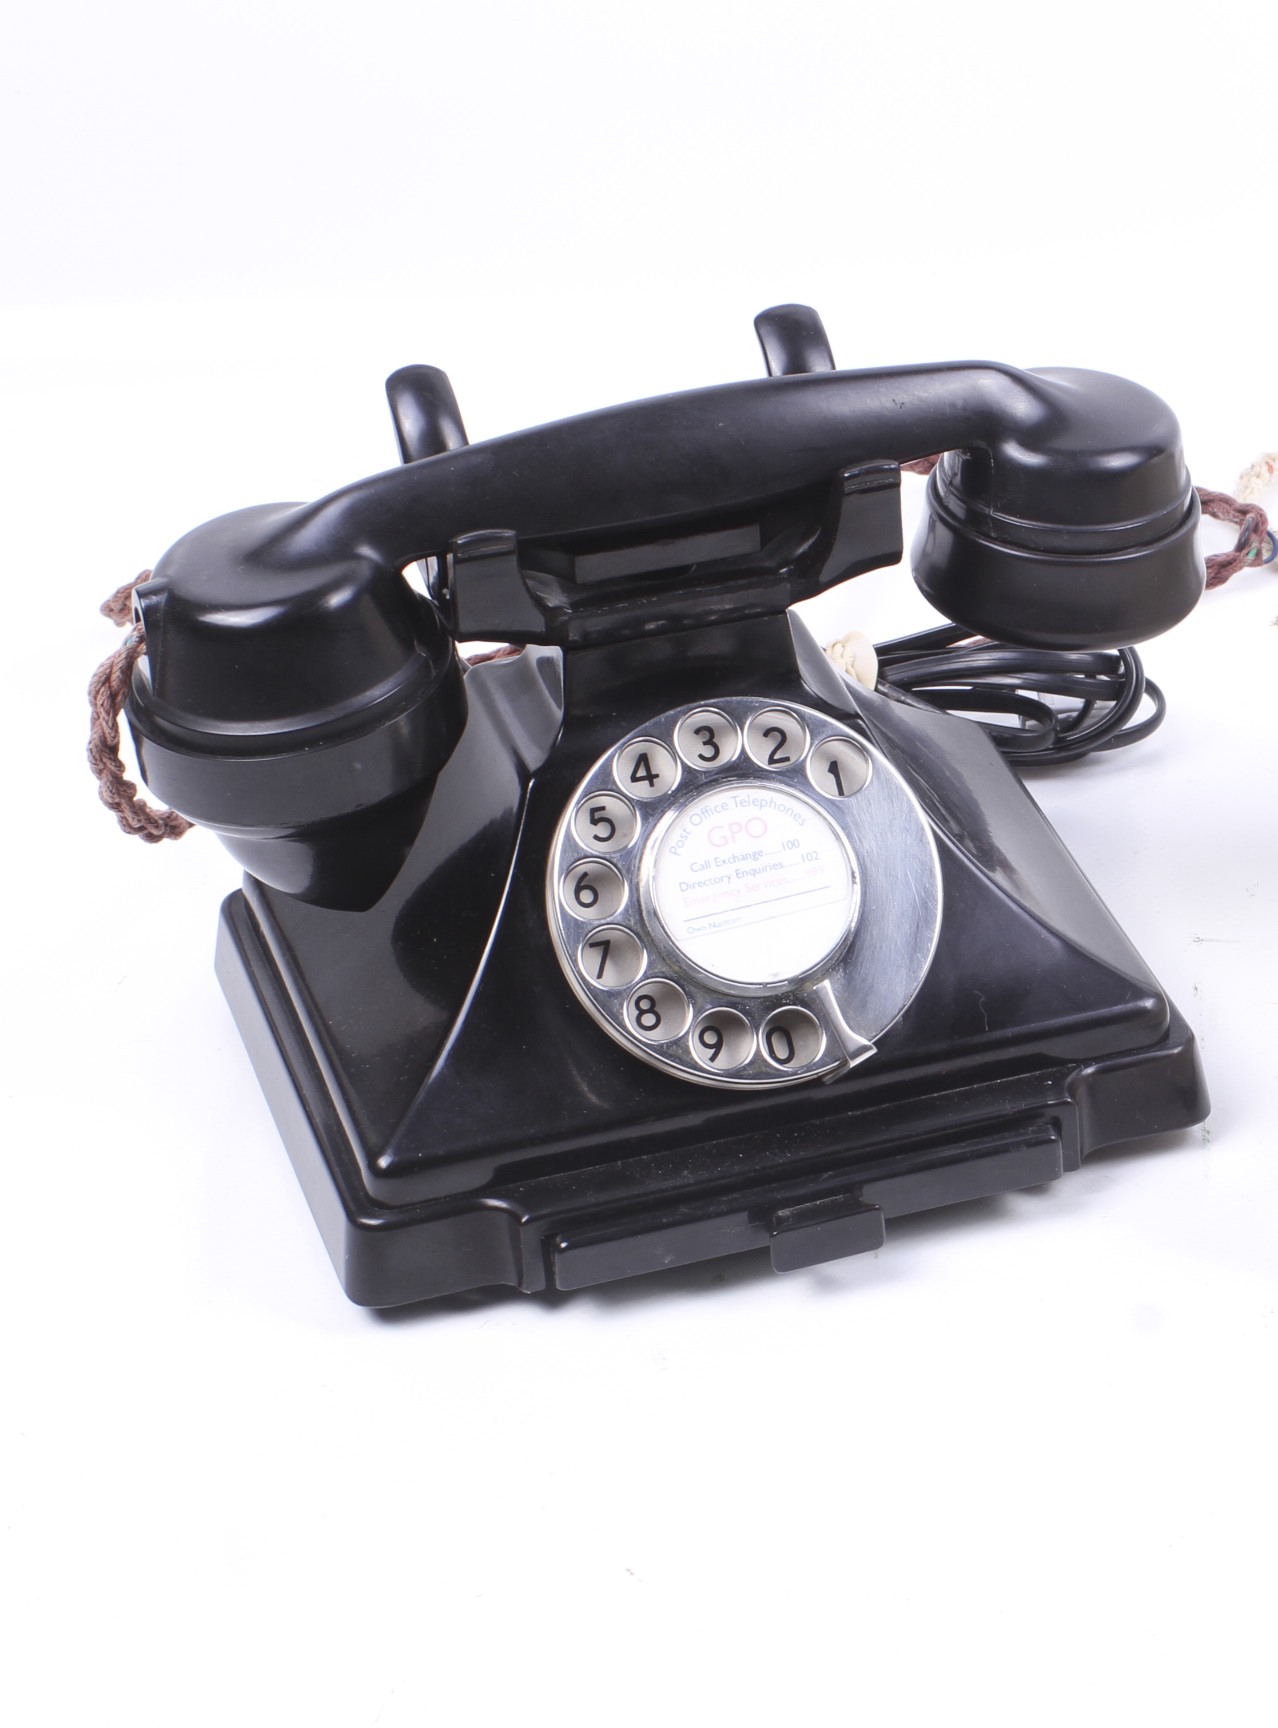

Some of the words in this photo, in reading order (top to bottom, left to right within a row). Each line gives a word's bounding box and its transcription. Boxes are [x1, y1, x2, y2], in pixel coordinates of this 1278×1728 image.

[693, 726, 721, 762] 3
[762, 726, 790, 765] 2
[630, 752, 659, 788] 4
[828, 760, 845, 796] 1
[589, 806, 616, 842] 5
[669, 825, 692, 856] Post
[689, 802, 729, 826] Office
[731, 795, 807, 827] Telephones
[707, 817, 768, 847] GPO
[679, 871, 732, 892] Directory
[735, 861, 784, 879] Enquiries
[800, 851, 820, 863] 102
[690, 860, 711, 873] Call
[574, 871, 599, 908] 6
[589, 939, 612, 979] 7
[634, 994, 661, 1031] 8
[699, 1025, 724, 1062] 9
[766, 1026, 795, 1065] 0
